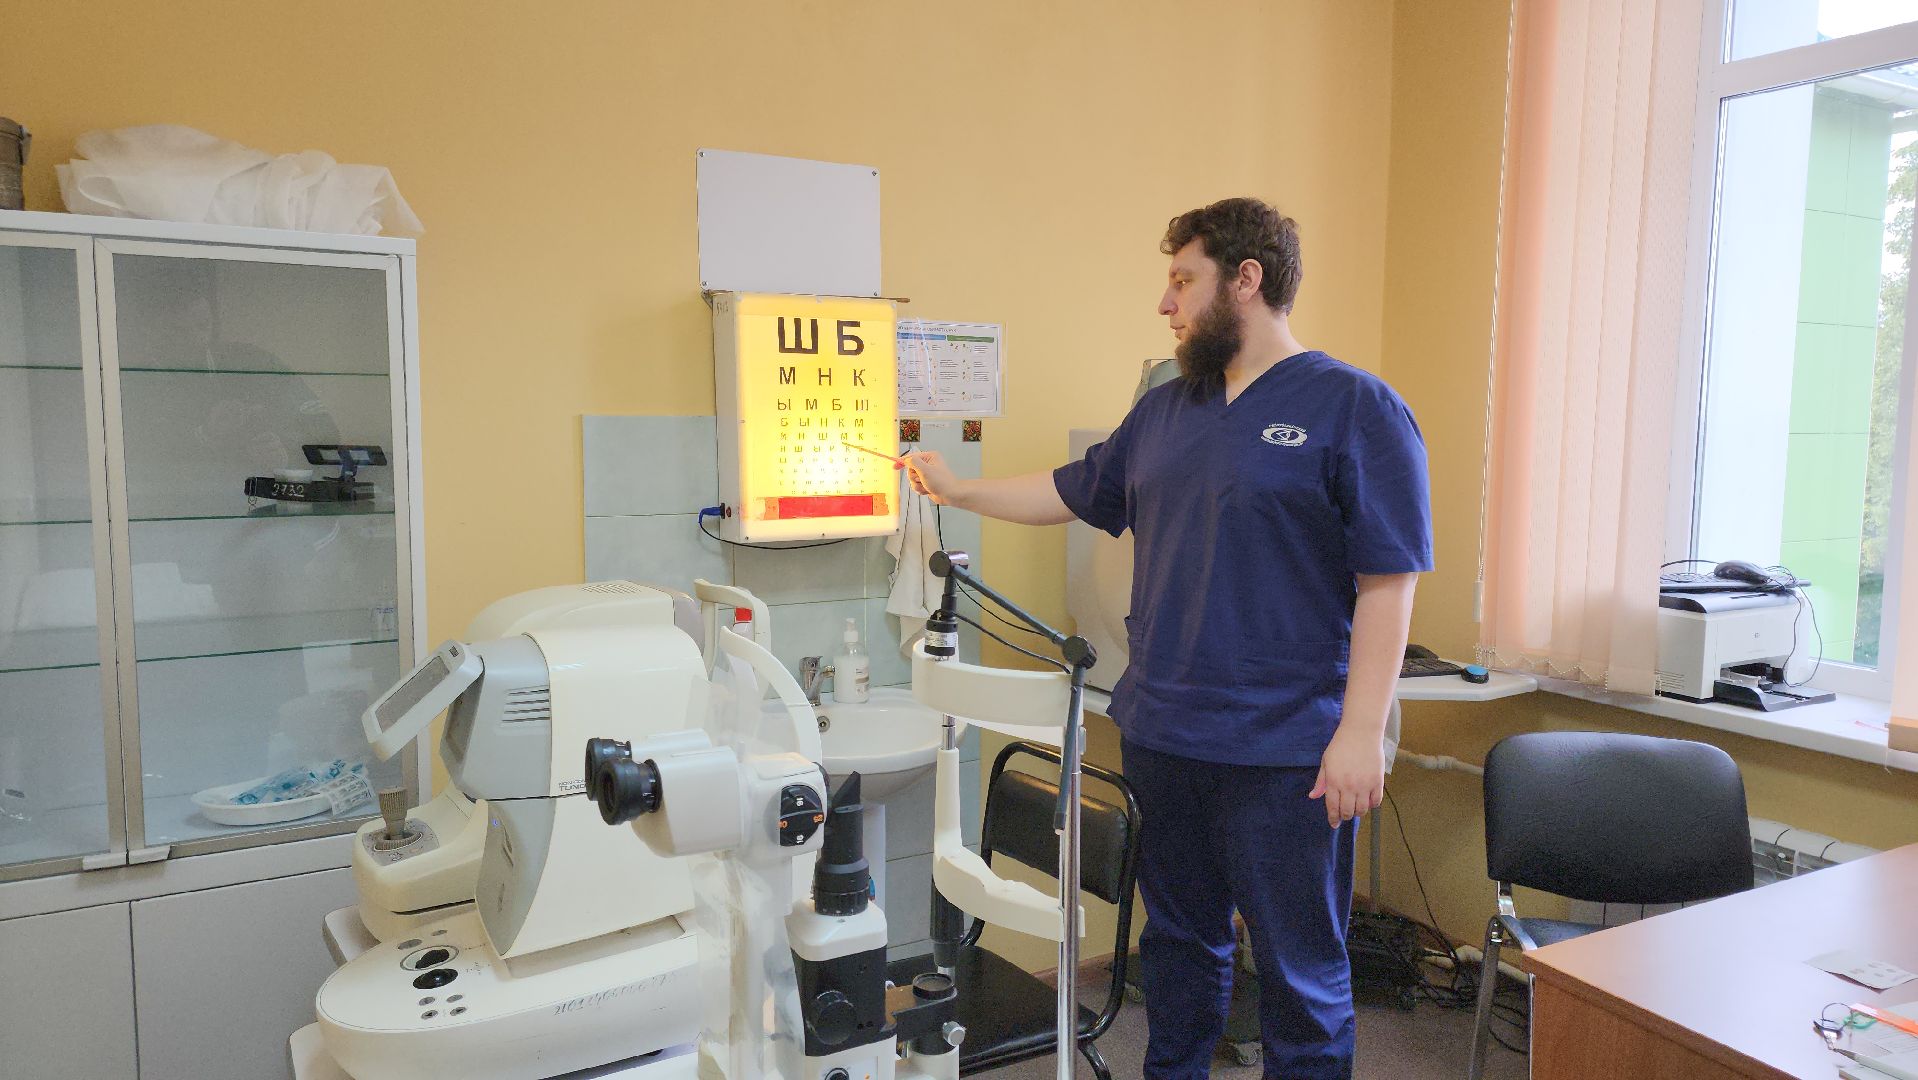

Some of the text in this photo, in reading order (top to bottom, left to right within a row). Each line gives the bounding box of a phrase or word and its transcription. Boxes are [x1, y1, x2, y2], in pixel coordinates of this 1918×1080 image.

[777, 316, 865, 356] Ш Б
[779, 366, 866, 387] М Н К
[777, 398, 869, 412] Ы М Б Ш
